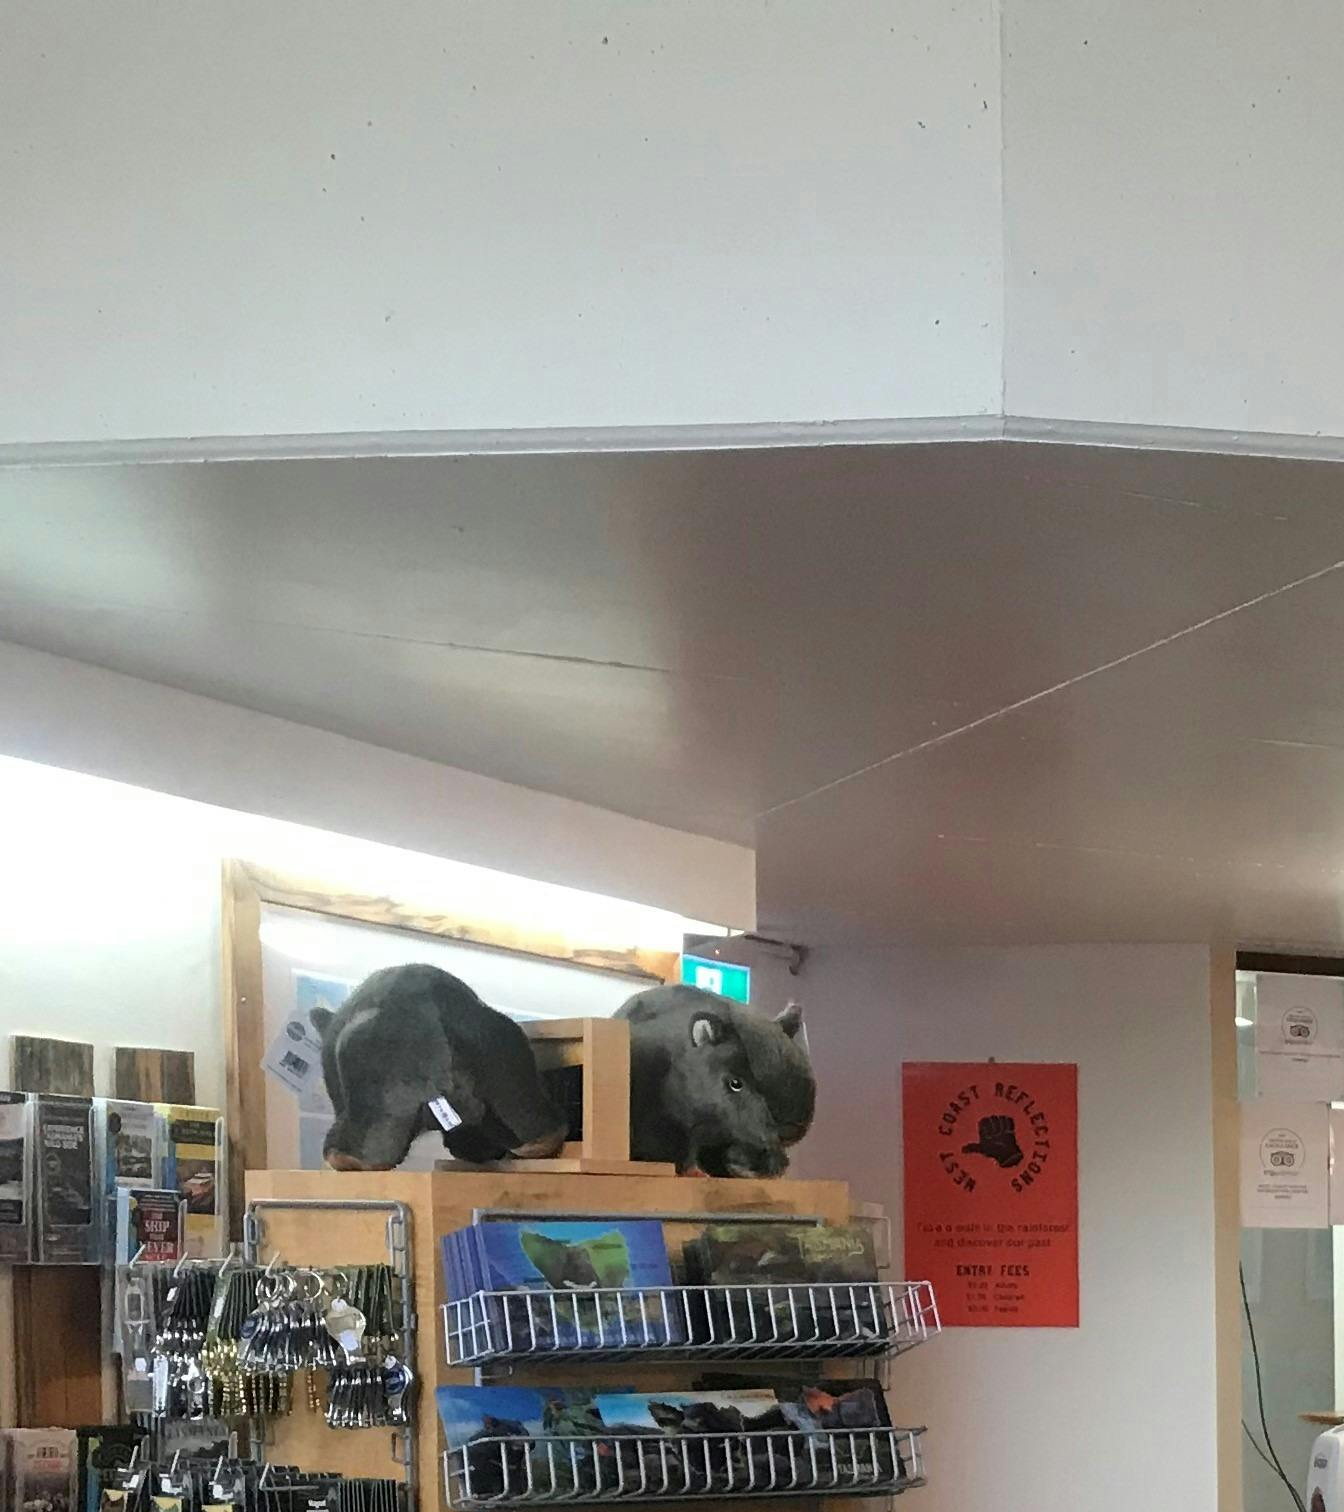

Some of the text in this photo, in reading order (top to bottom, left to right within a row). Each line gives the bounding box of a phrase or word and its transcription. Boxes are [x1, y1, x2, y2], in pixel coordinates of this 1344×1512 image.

[939, 1082, 1050, 1192] WEST COAST REFLECTIONS
[957, 1238, 1004, 1248] discover
[956, 1264, 1030, 1277] ENTRY FEES
